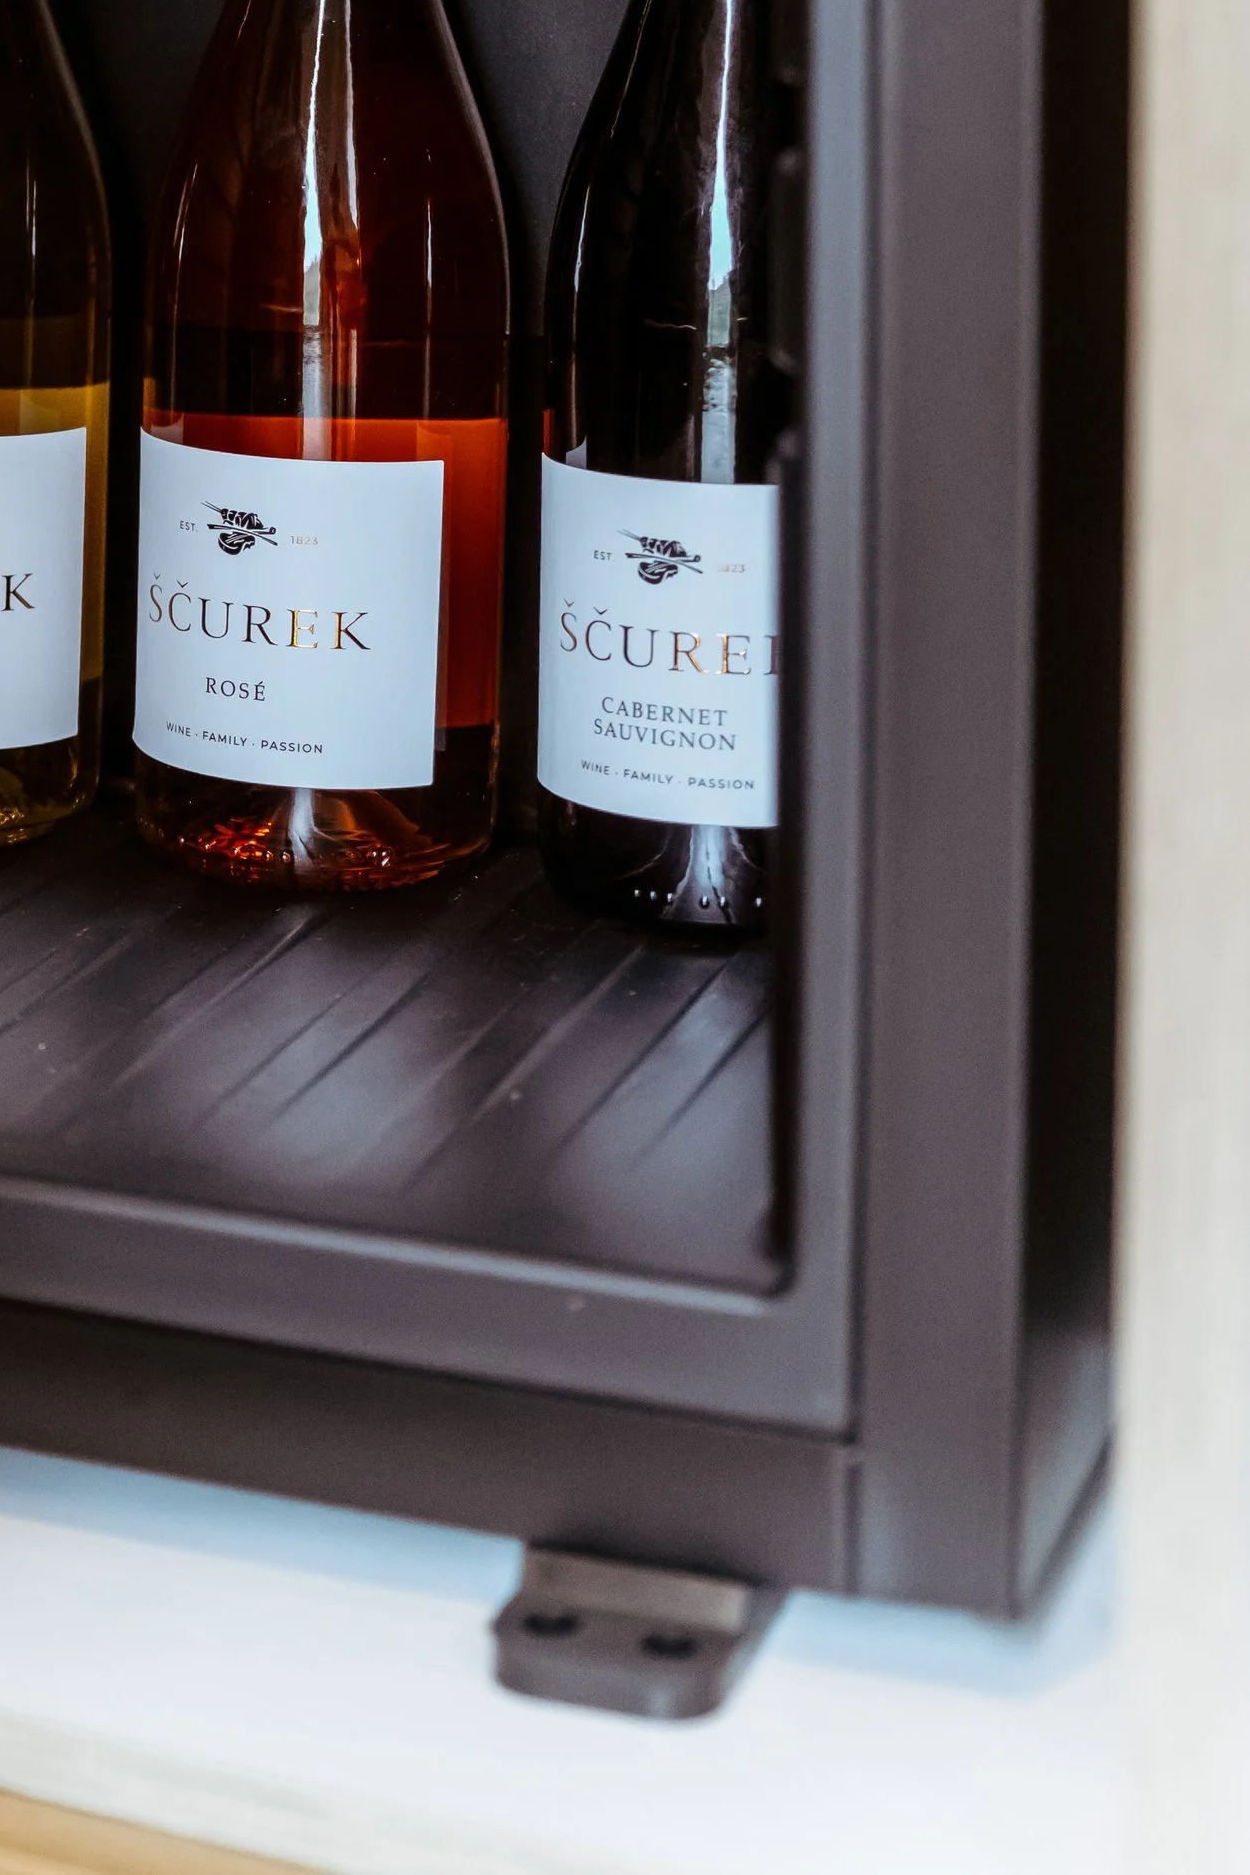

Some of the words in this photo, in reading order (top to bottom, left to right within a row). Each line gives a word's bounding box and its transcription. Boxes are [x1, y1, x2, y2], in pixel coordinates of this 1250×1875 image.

[179, 520, 197, 531] EST.
[290, 535, 318, 544] 1823
[148, 572, 370, 650] ŠČUREK
[205, 676, 266, 701] ROSÉ
[601, 696, 727, 726] CABERNET
[165, 720, 190, 737] WINE
[202, 730, 247, 746] FAMILY
[260, 739, 322, 753] PASSION
[593, 718, 736, 750] SAUVIGNON
[580, 759, 609, 775] WINE
[623, 768, 673, 785] FAMILY
[688, 776, 754, 789] PASSION
